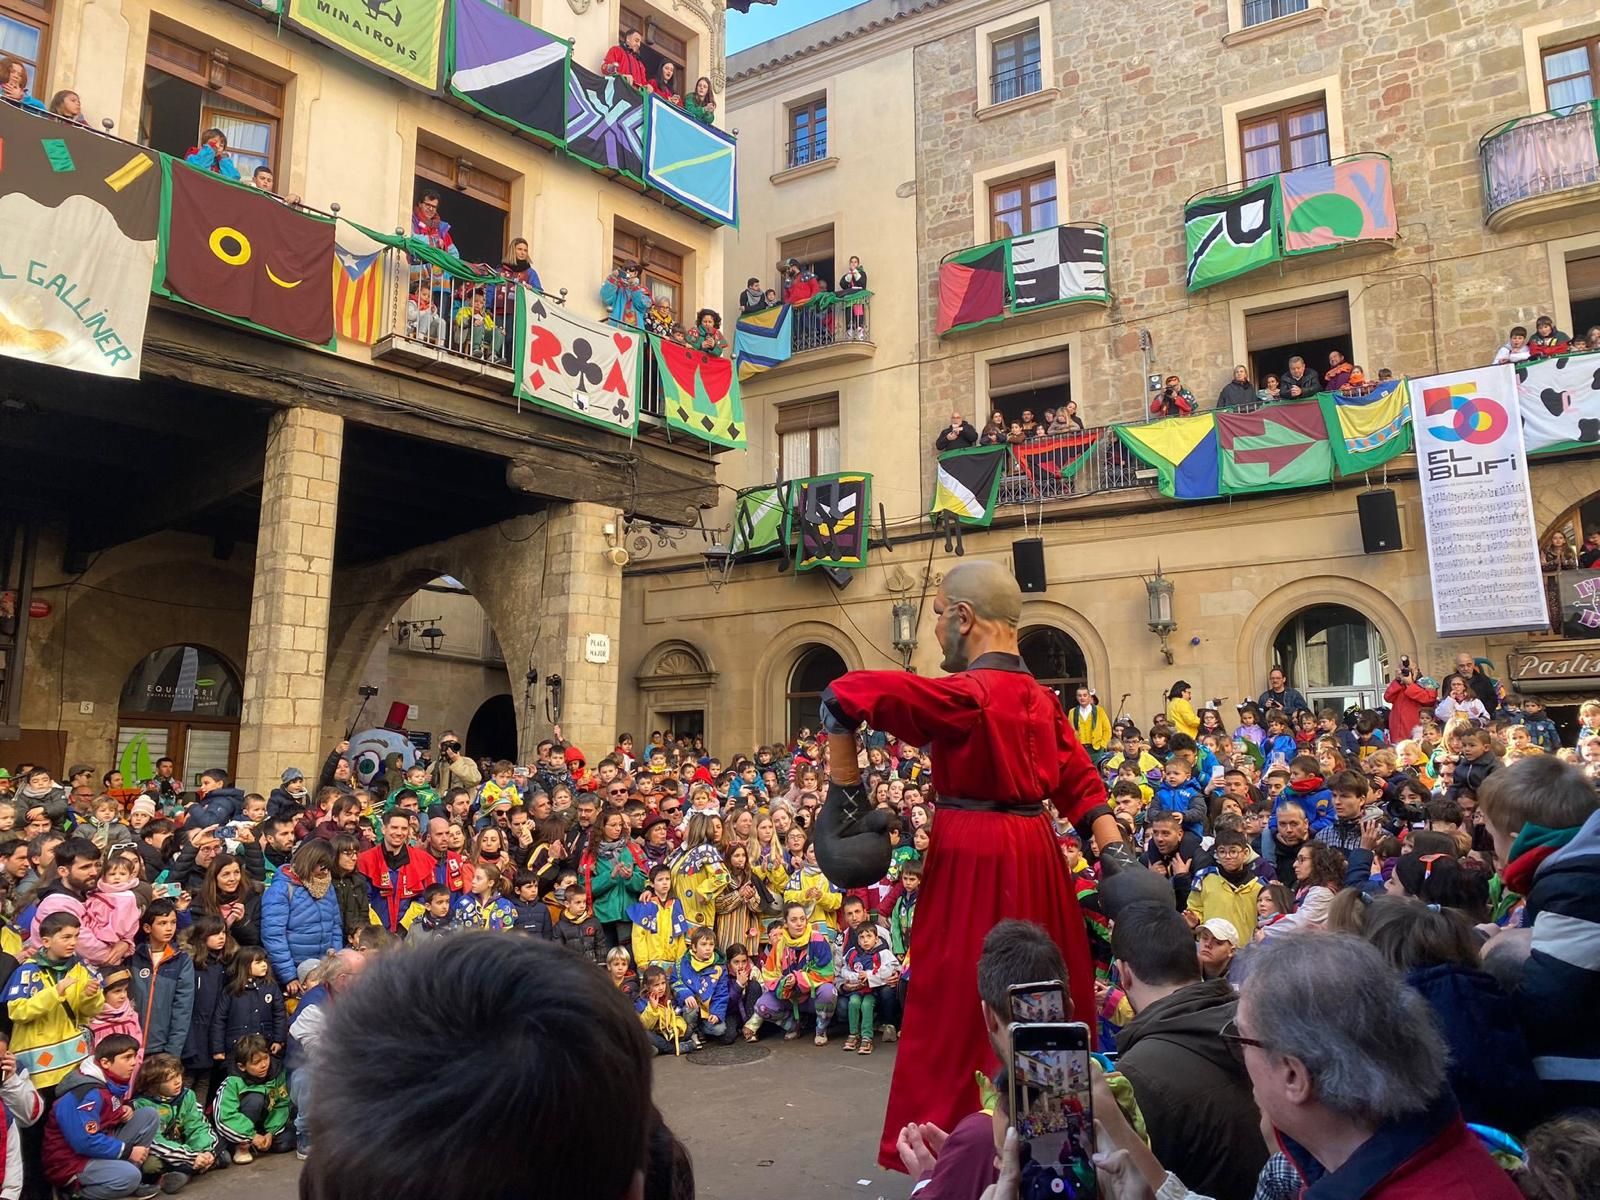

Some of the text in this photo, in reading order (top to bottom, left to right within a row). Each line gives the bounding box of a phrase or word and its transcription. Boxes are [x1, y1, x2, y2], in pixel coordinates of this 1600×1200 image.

[317, 0, 417, 61] MINAIRONS
[1423, 381, 1509, 445] 50
[1427, 448, 1473, 466] EL
[147, 684, 213, 697] EQUILIBRI
